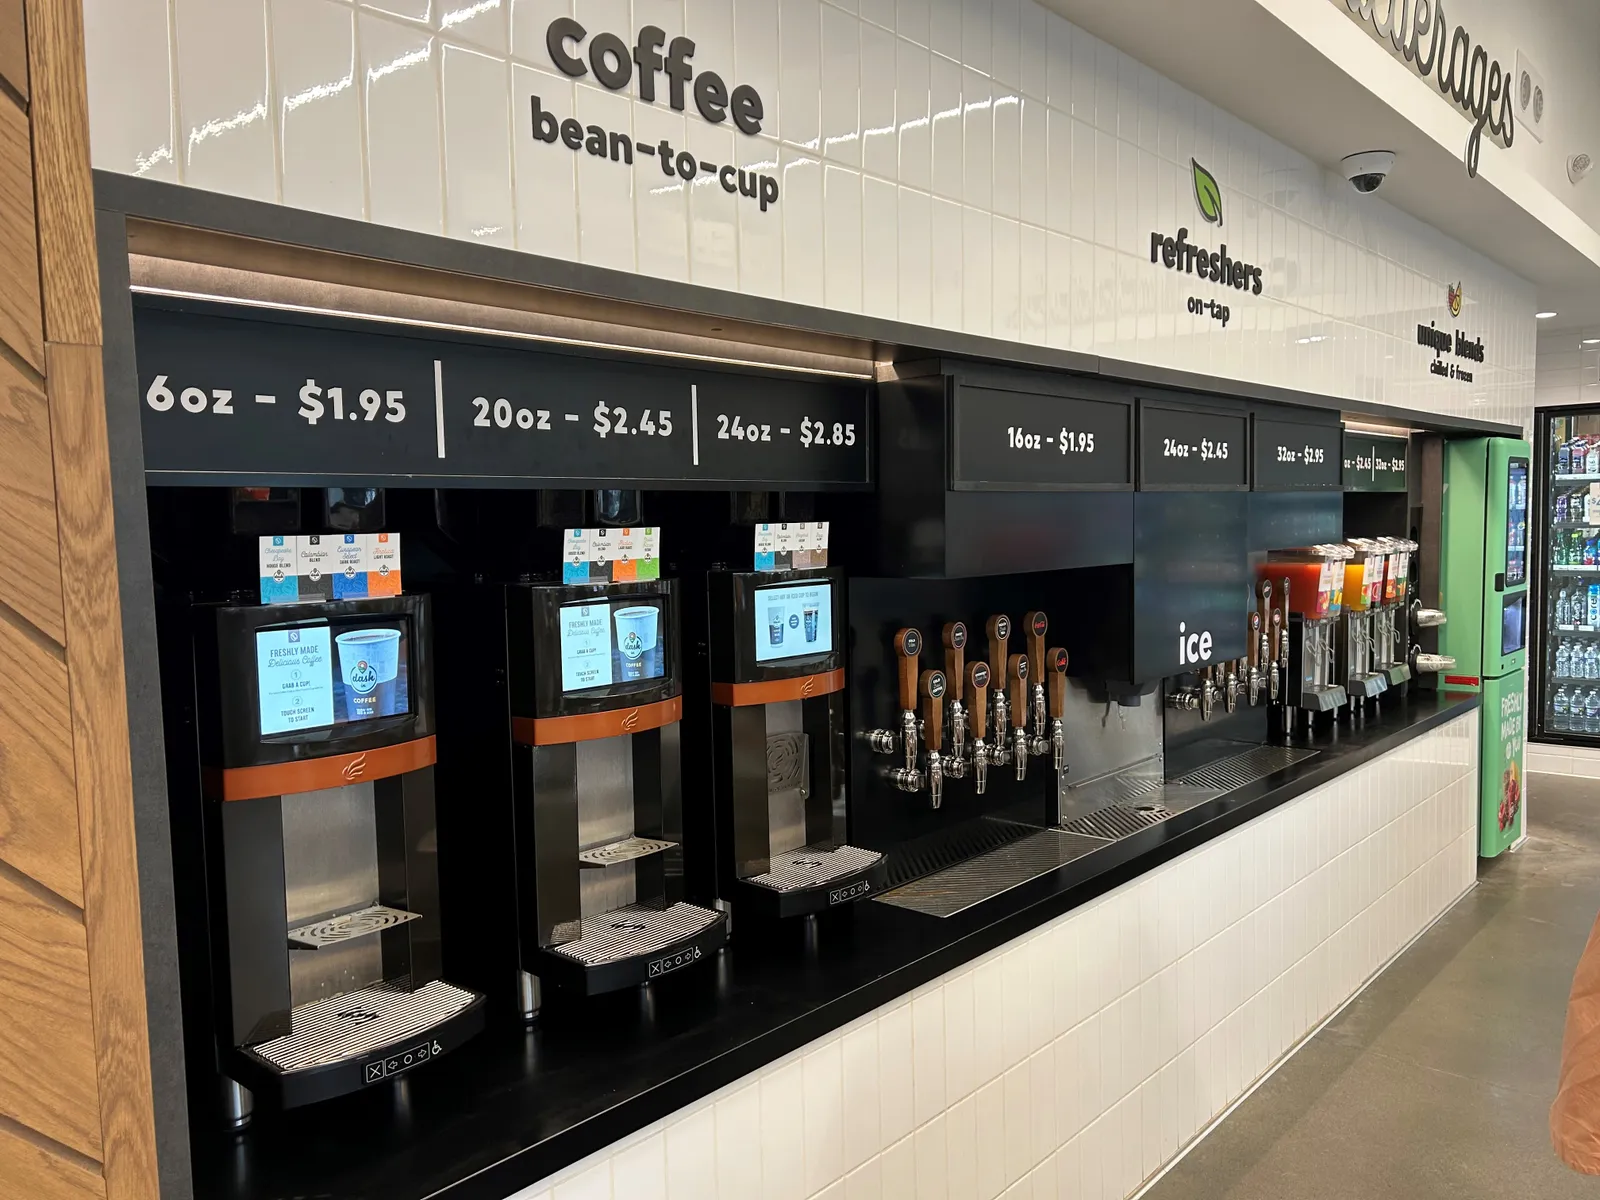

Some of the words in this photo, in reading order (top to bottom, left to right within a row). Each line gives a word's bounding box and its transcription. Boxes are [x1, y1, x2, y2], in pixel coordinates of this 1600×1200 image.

[546, 17, 764, 136] coffee
[531, 95, 779, 212] bean-to-cup
[1151, 227, 1263, 296] refreshers
[1187, 296, 1230, 327] on-tap
[1417, 320, 1452, 358] unique
[1455, 329, 1485, 363] blends
[1430, 359, 1448, 377] chilled
[1450, 364, 1455, 378] &
[1456, 364, 1472, 382] frozen
[297, 378, 406, 425] $1.95
[472, 396, 551, 430] 20oz
[594, 400, 673, 438] $2.45
[716, 414, 771, 442] 24oz
[800, 416, 856, 448] $2.85
[1008, 426, 1041, 450] 16oz
[1059, 428, 1095, 455] $1.95
[1163, 438, 1189, 458] 24oz
[1201, 437, 1229, 461] $2.45
[1277, 446, 1296, 462] 32oz
[1304, 445, 1324, 465] $2.95
[590, 618, 603, 627] MADE
[270, 647, 299, 658] FRESHLY
[300, 645, 319, 655] MADE
[1180, 621, 1213, 665] ice
[267, 658, 301, 668] Delicious
[302, 655, 323, 667] Coffee
[281, 709, 296, 717] TOUCH
